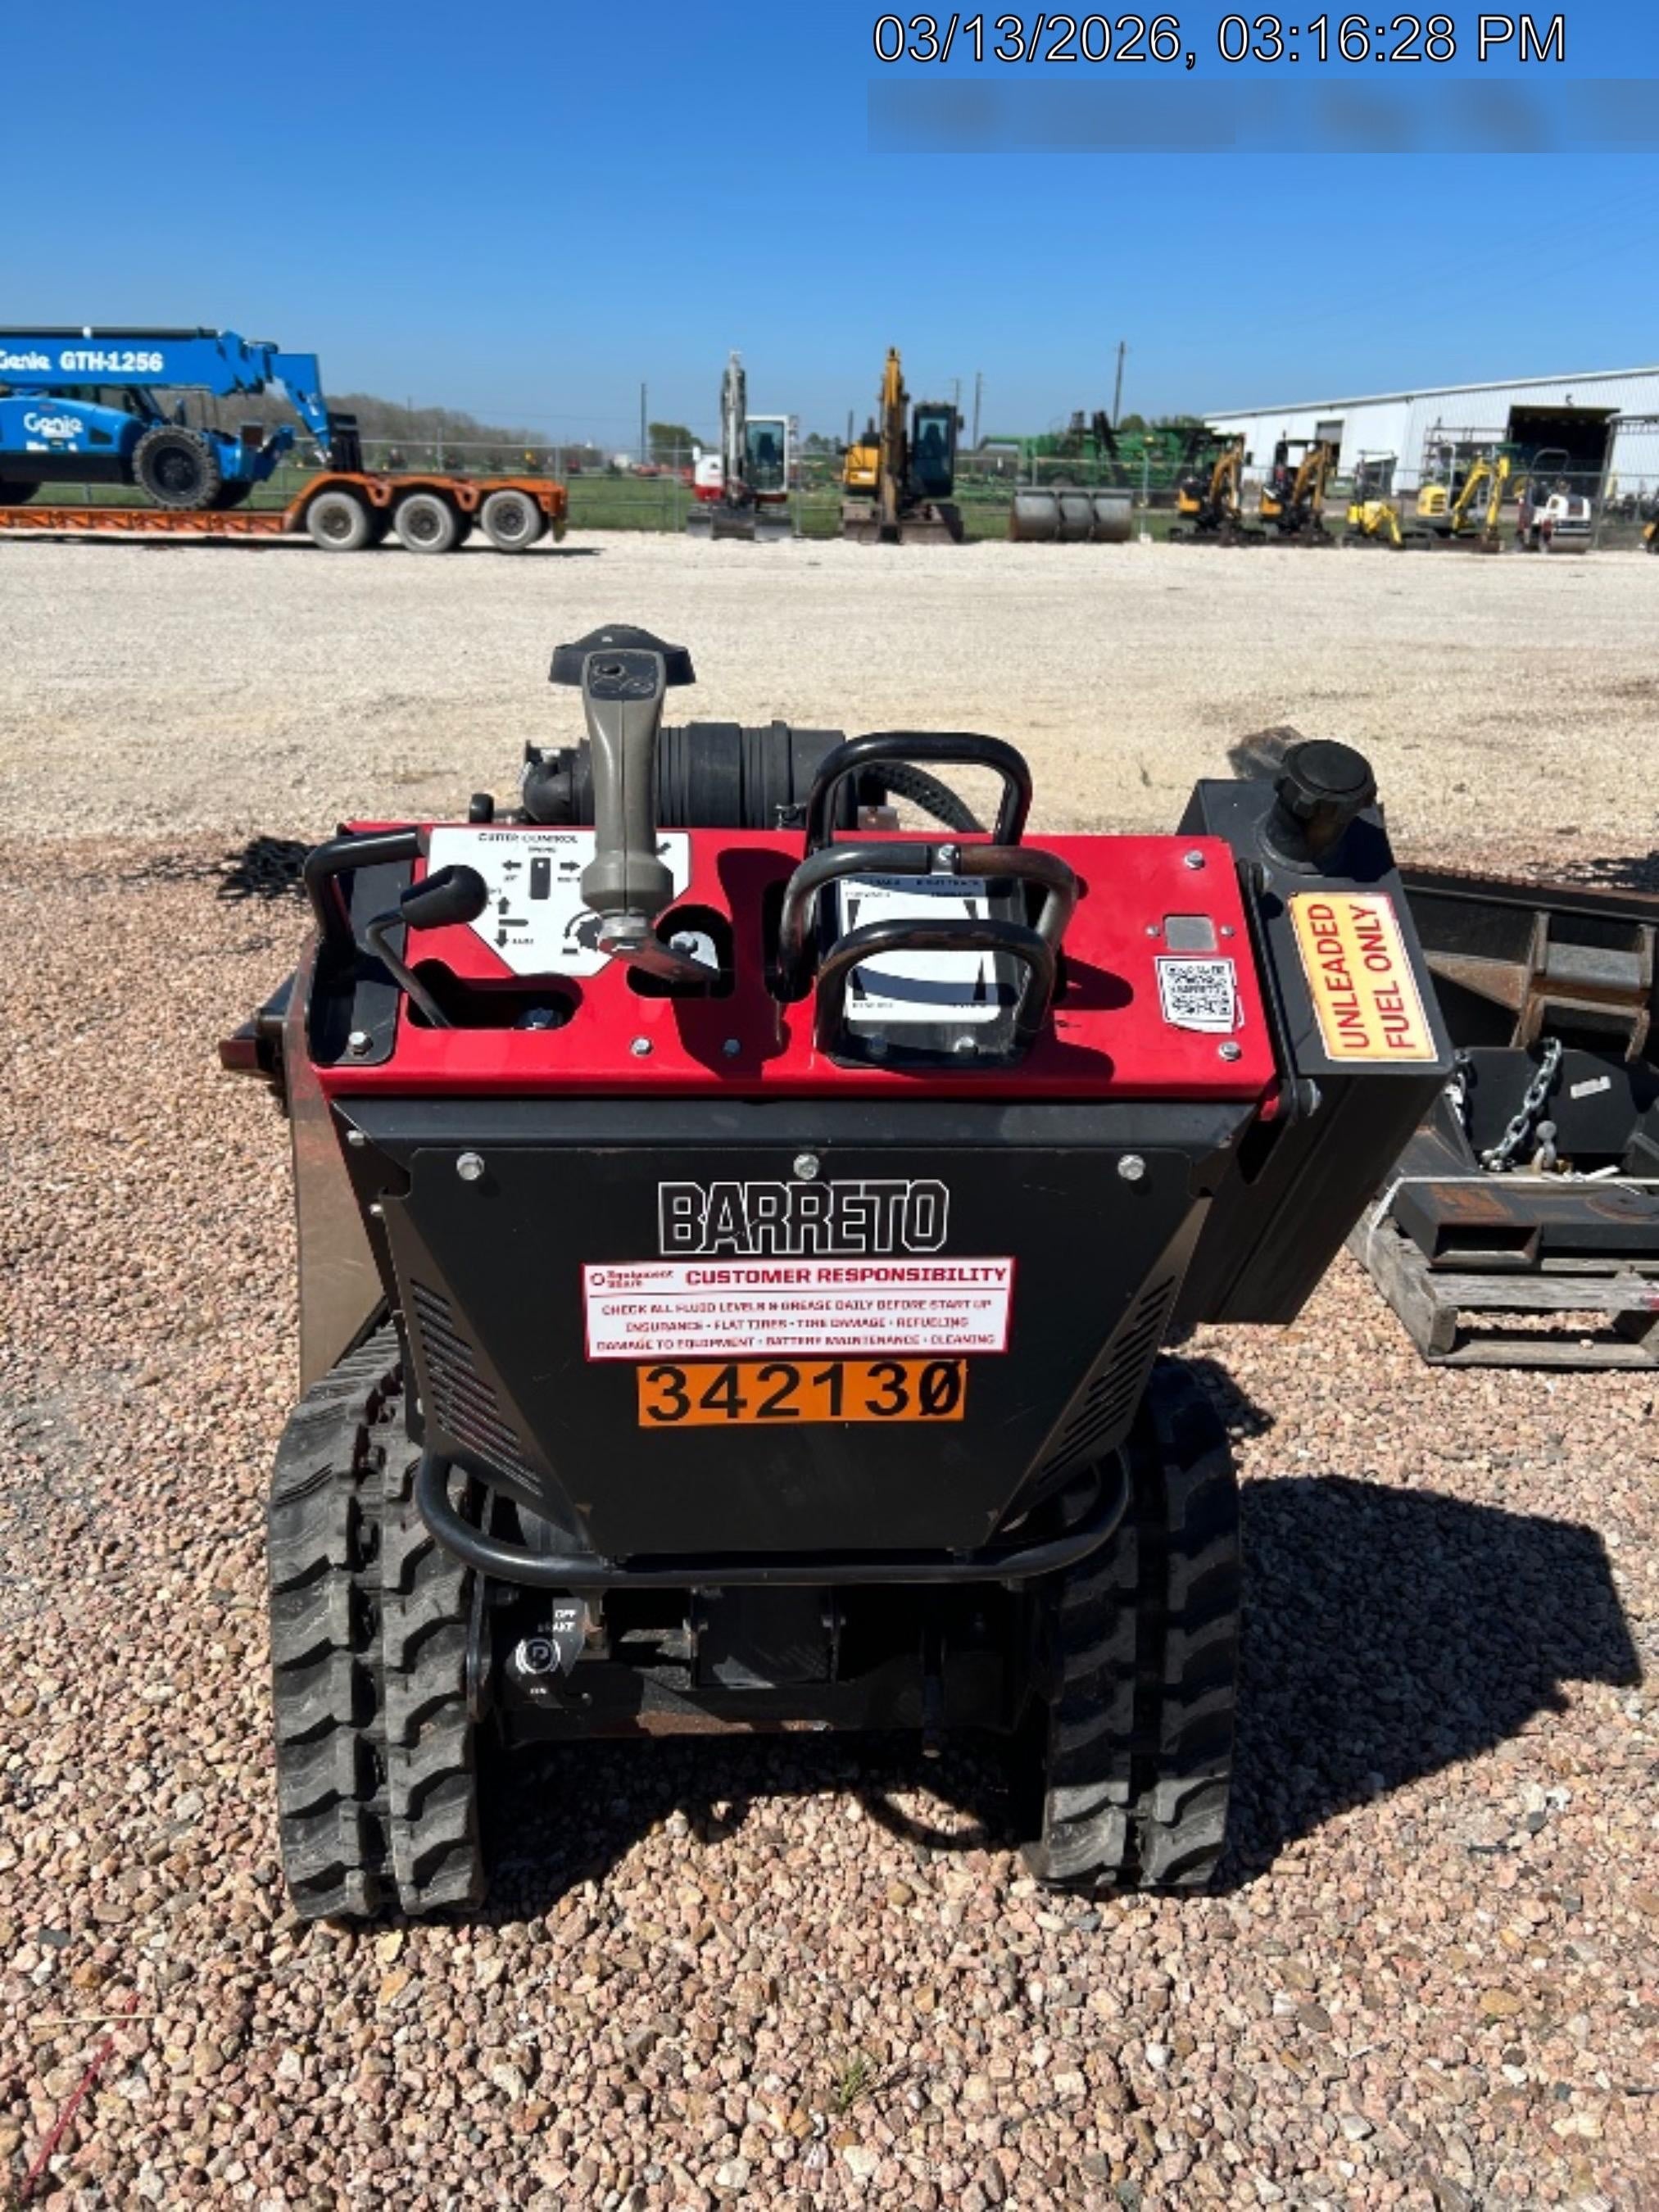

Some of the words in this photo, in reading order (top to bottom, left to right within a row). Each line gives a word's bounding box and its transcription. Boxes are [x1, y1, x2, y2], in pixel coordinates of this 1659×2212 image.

[60, 351, 164, 372] GTH-1256
[24, 412, 84, 435] Genie
[1349, 904, 1392, 974] ONLY
[1308, 904, 1370, 1049] UNLEADED
[1372, 981, 1416, 1049] FUEL
[658, 1180, 950, 1254] BARRETO
[686, 1269, 811, 1285] CUSTOMER
[817, 1267, 1007, 1284] RESPONSIBILITY
[601, 1304, 647, 1316] CHECK
[650, 1303, 673, 1314] ALL
[675, 1303, 717, 1313] FLUID
[719, 1302, 766, 1312] LEVELS
[781, 1300, 831, 1312] GREASE
[835, 1300, 873, 1311] DAILY
[877, 1299, 926, 1311] BEFORE
[928, 1299, 971, 1309] START
[625, 1321, 703, 1333] INSURANCE
[714, 1319, 743, 1330] FLAT
[747, 1319, 787, 1329] TIRES
[797, 1318, 827, 1328] TIRE
[830, 1317, 886, 1328] DAMAGE
[896, 1317, 970, 1329] REFUELING
[596, 1339, 653, 1351] DAMAGE
[657, 1338, 673, 1349] TO
[678, 1336, 754, 1349] EQUIPMENT
[766, 1335, 821, 1347] BATTERY
[825, 1335, 920, 1346] MAINTENANCE
[931, 1334, 996, 1345] CLEANING
[646, 1361, 963, 1422] 342130
